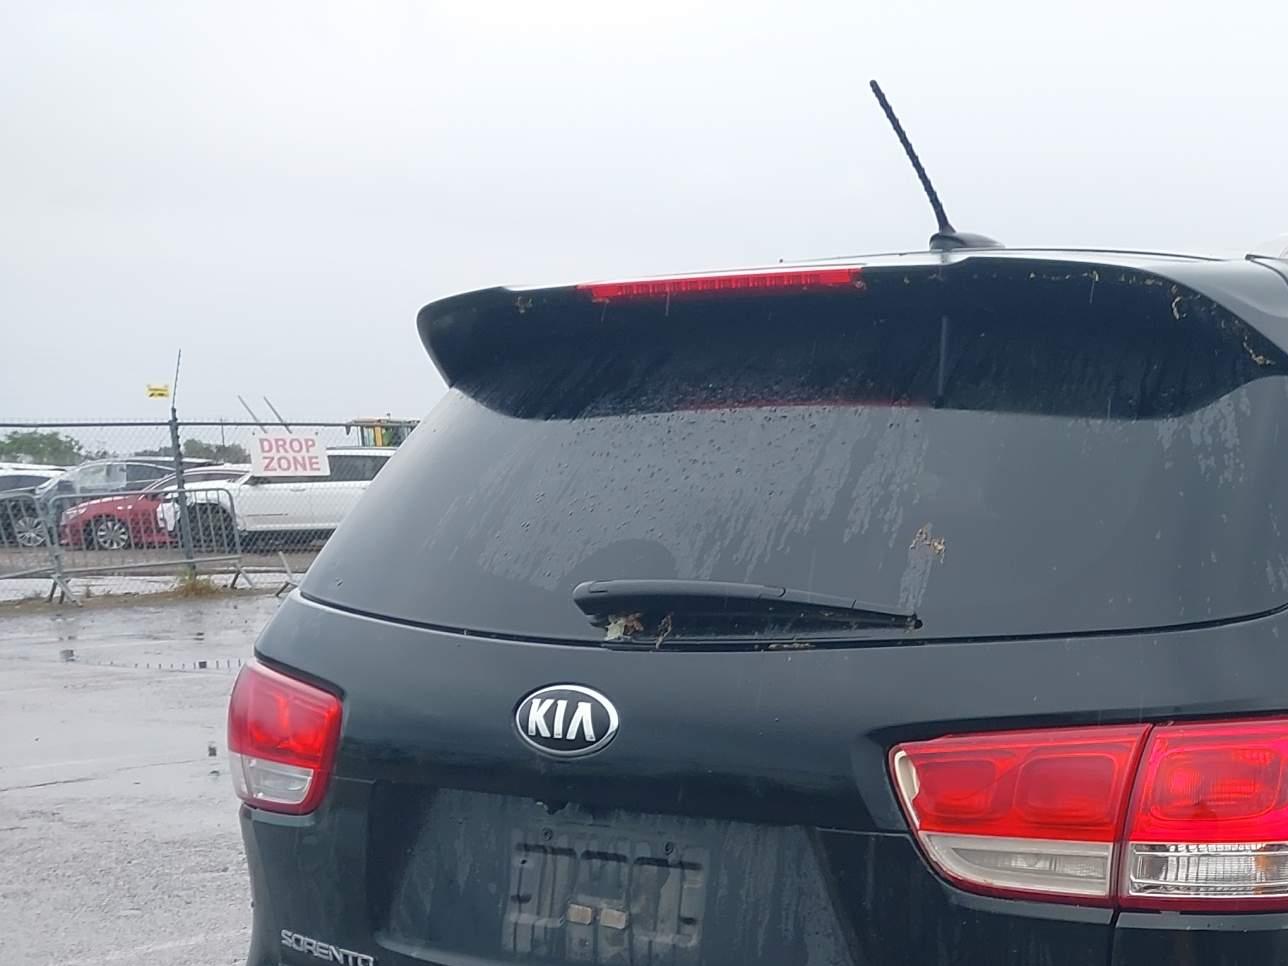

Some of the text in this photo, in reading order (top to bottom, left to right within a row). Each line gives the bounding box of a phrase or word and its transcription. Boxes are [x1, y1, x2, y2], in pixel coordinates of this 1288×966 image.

[259, 438, 316, 454] DROP
[262, 455, 321, 472] ZONE
[528, 698, 596, 742] KIA
